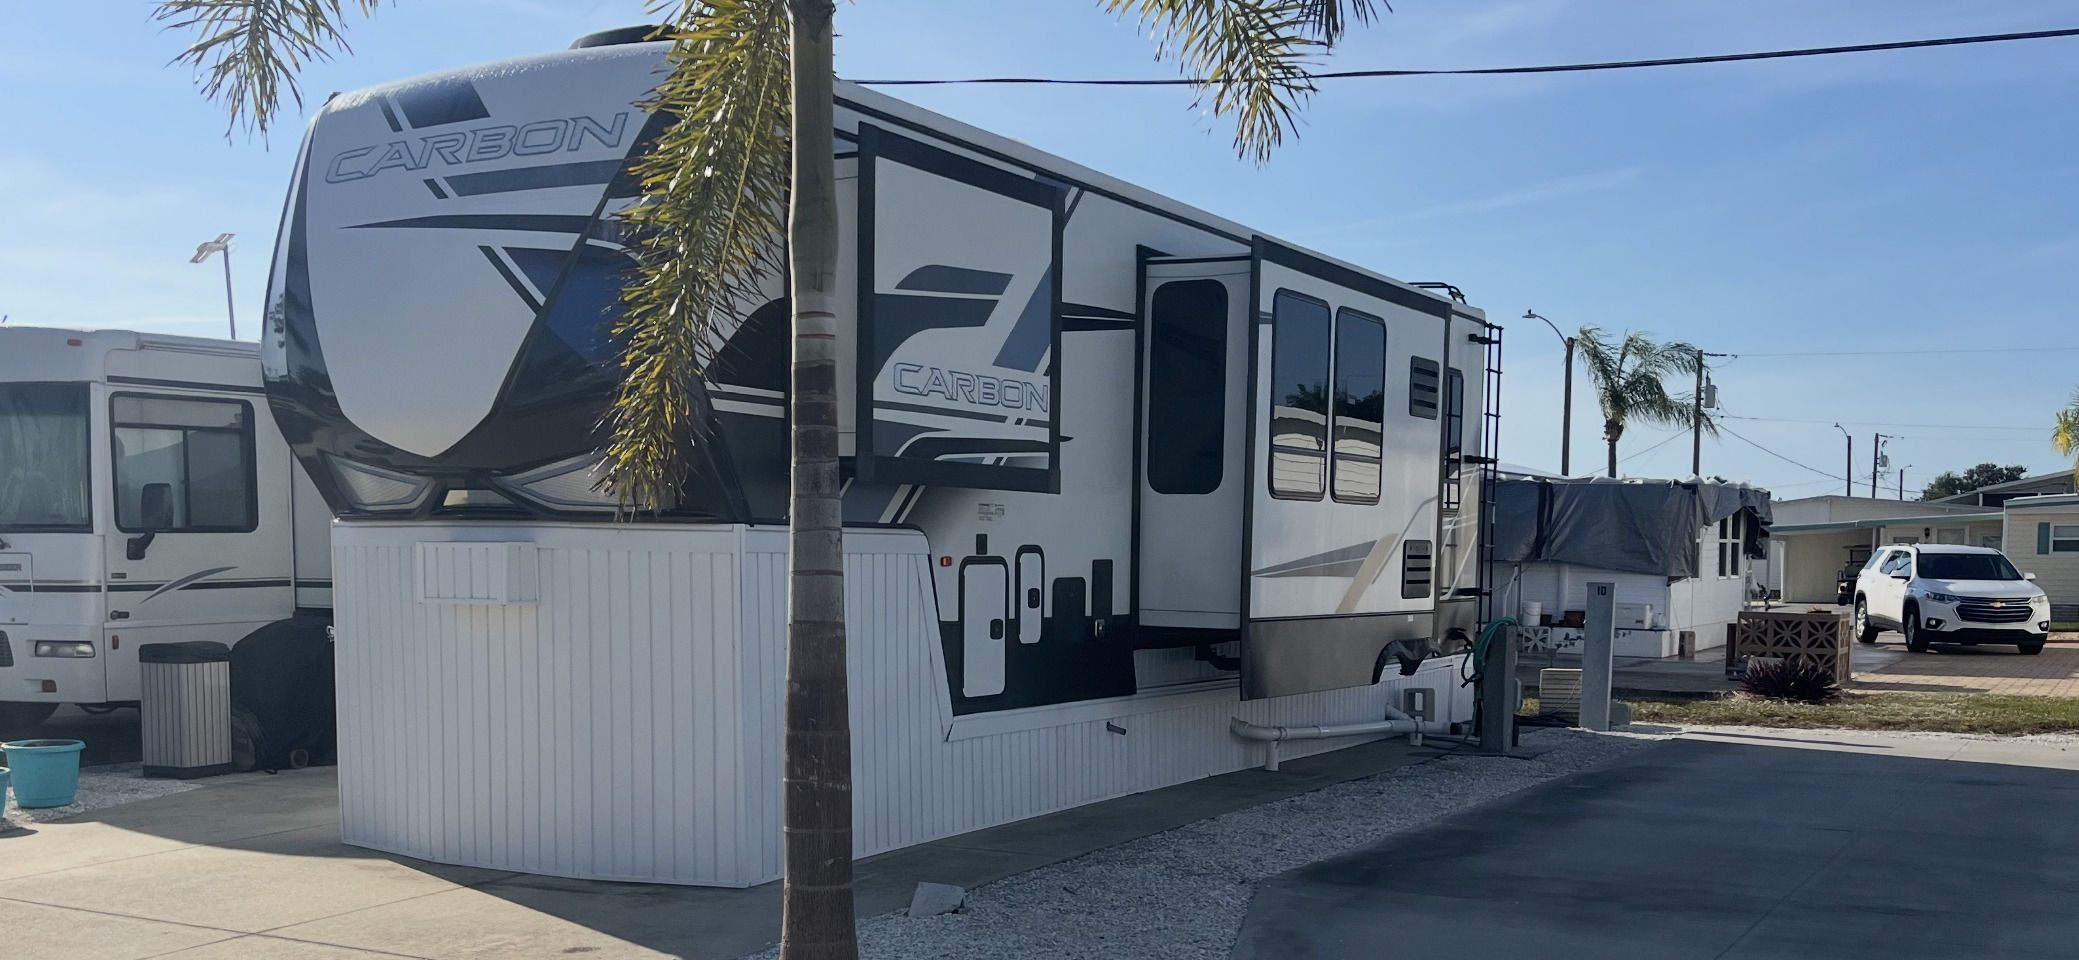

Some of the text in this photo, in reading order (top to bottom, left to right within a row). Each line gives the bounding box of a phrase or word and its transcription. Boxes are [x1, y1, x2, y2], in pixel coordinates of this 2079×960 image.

[326, 112, 629, 184] CARBON
[893, 362, 1049, 413] CARBON
[1597, 585, 1607, 596] 10
